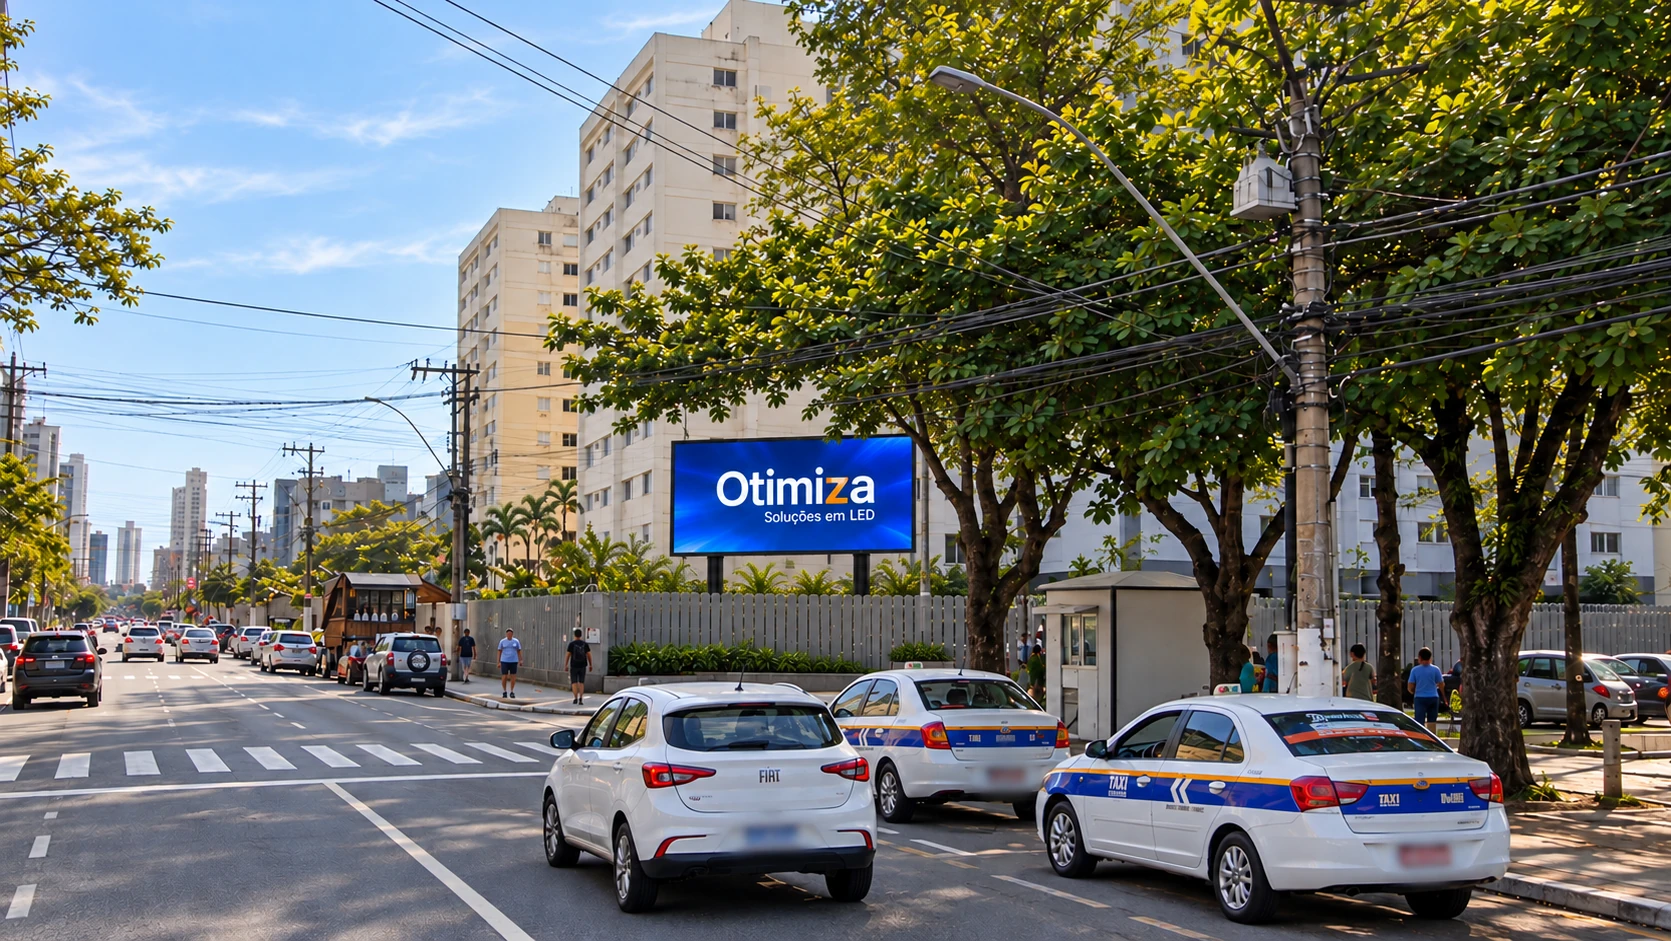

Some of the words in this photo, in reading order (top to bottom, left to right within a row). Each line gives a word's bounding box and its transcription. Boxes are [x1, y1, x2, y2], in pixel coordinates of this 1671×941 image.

[716, 466, 875, 507] Otimiza
[764, 510, 821, 525] Soluções
[825, 511, 845, 522] em
[850, 509, 875, 521] LED
[759, 767, 781, 783] FIAT
[1109, 775, 1129, 791] TAXI
[1379, 793, 1400, 804] TAXI
